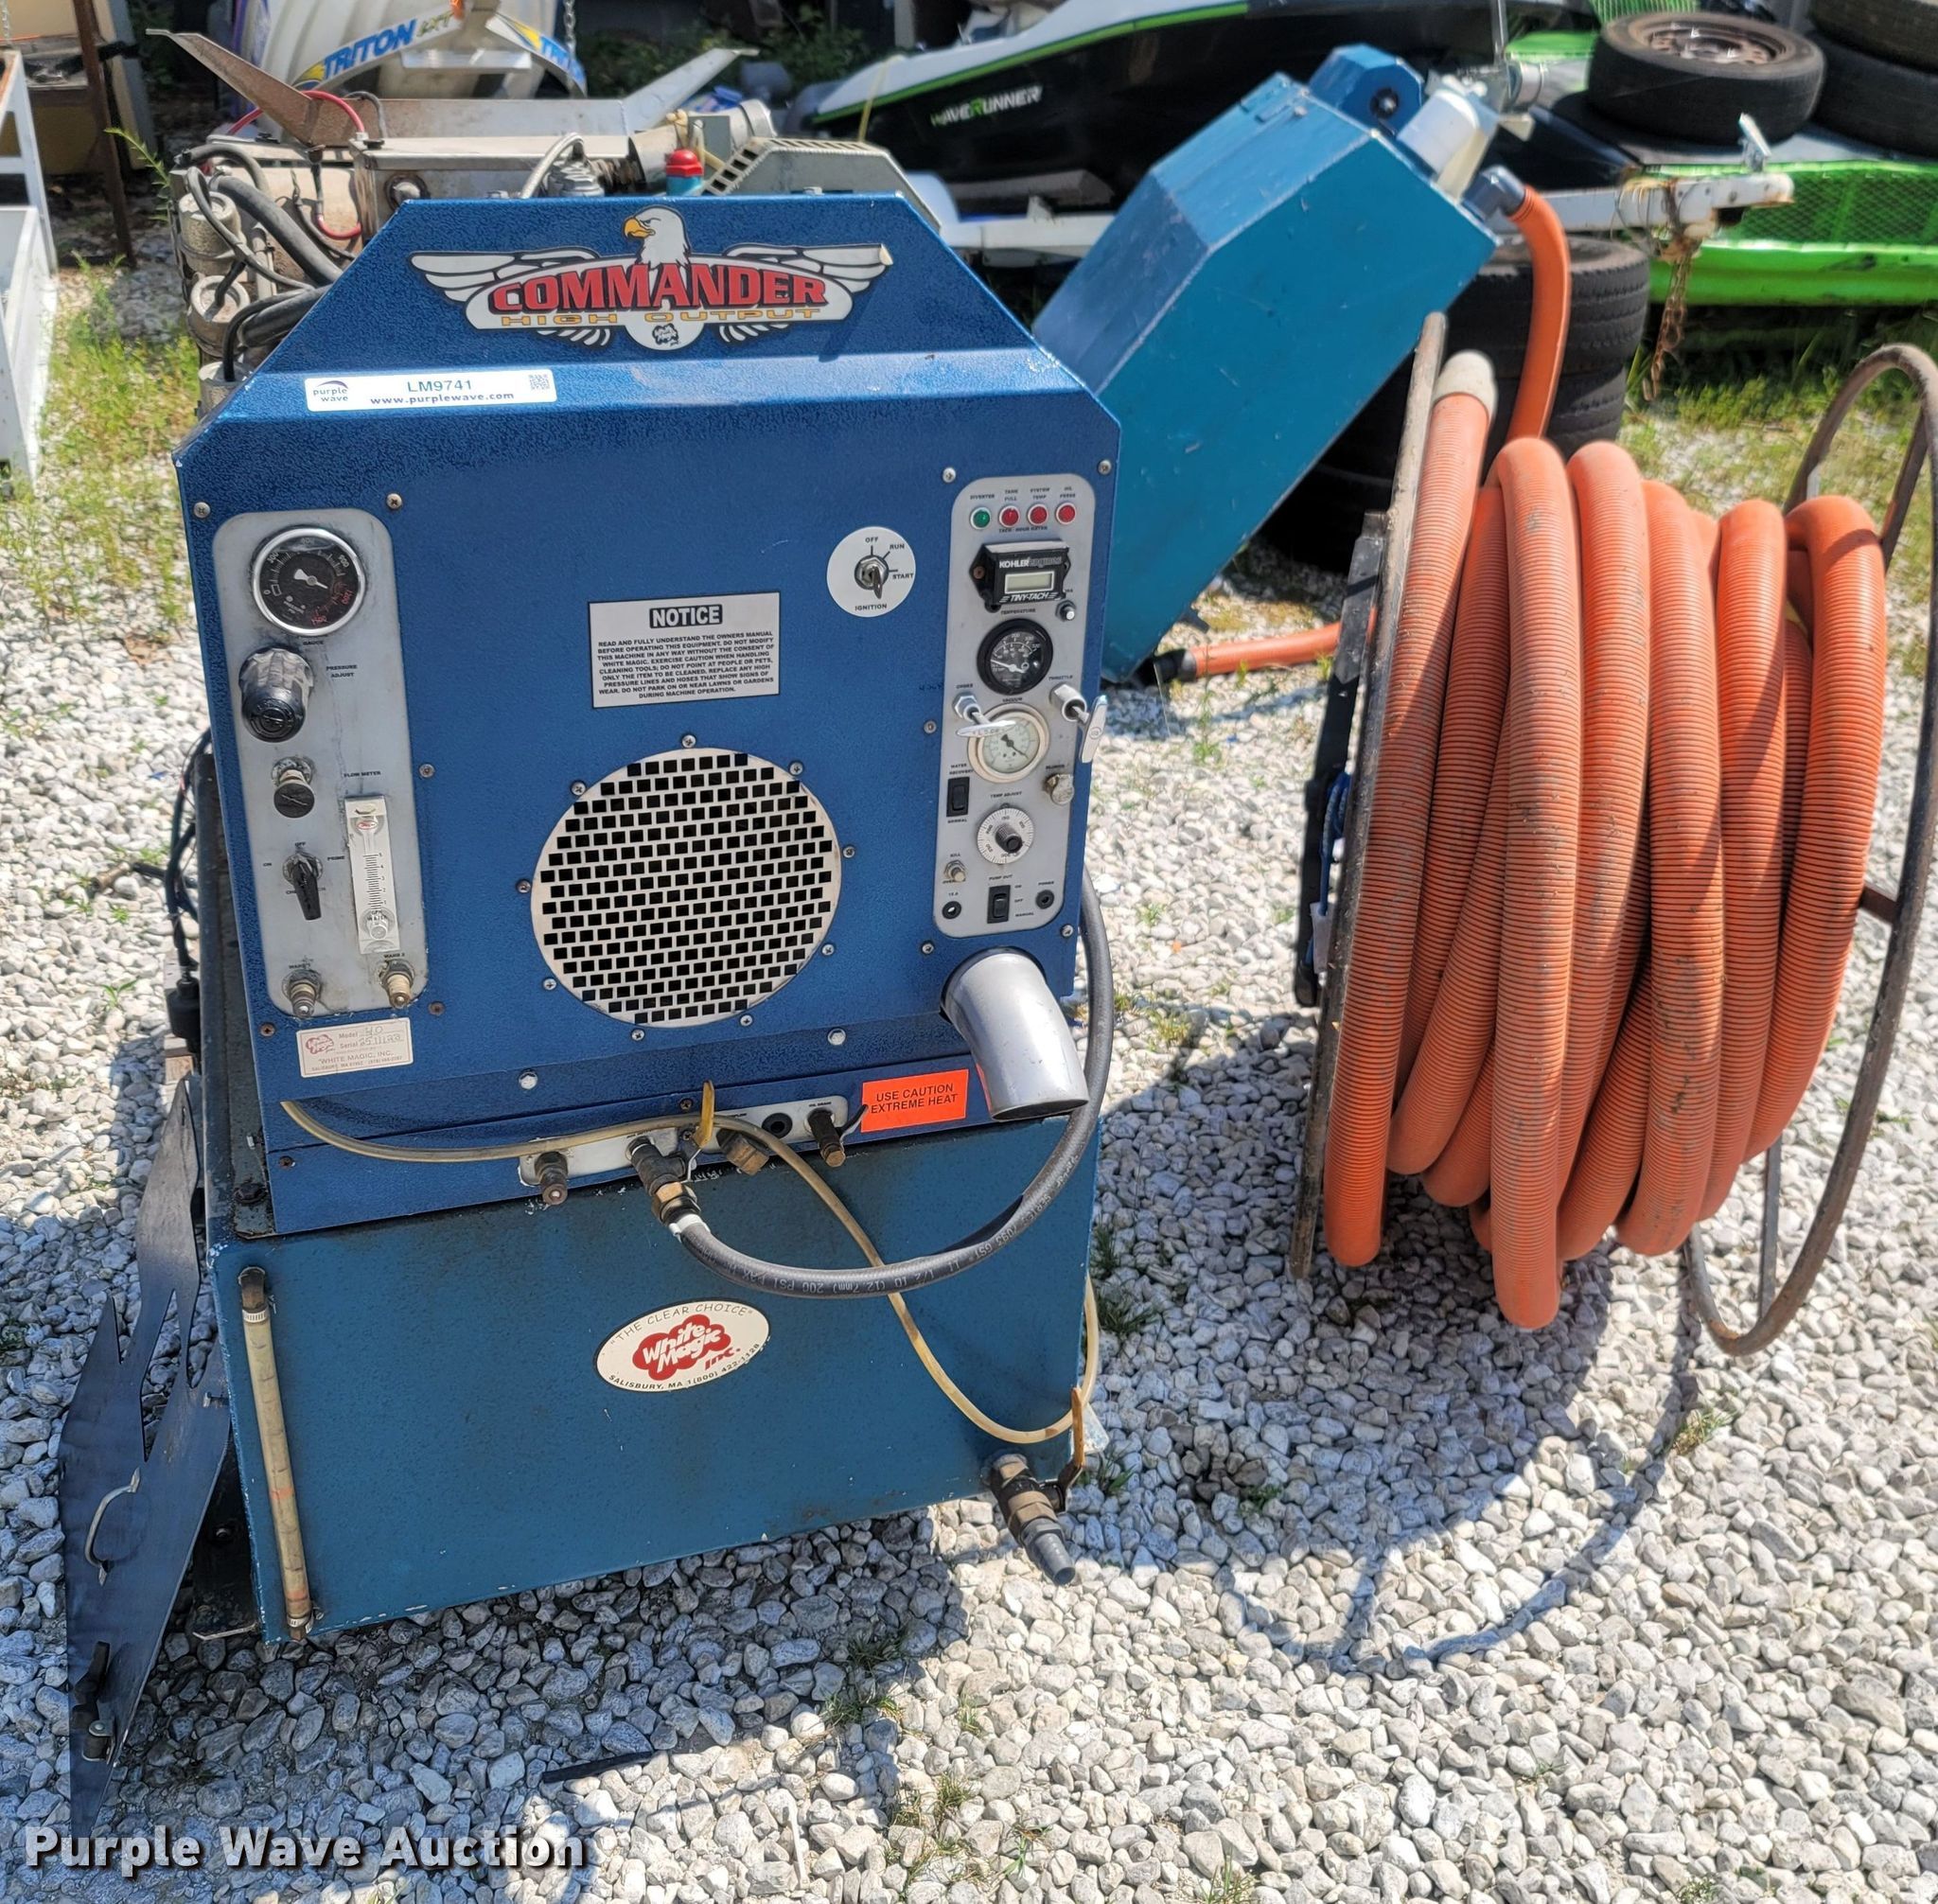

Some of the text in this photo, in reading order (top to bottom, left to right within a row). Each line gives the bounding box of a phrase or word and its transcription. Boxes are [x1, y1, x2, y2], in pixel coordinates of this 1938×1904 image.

[322, 19, 418, 79] TRITON
[930, 85, 1043, 126] WAVERUNNER
[488, 263, 828, 313] COMMANDER
[502, 309, 820, 326] HIGH OUTPUT
[313, 387, 347, 396] purple
[408, 380, 471, 393] LM9741
[371, 392, 514, 405] www.purplewave.com
[999, 558, 1030, 568] KOHLER
[1011, 592, 1048, 602] TINY-TACH
[652, 606, 720, 627] NOTICE
[876, 1084, 953, 1102] USE CAUTION
[871, 1094, 959, 1113] EXTREME HEAT
[773, 1281, 795, 1291] PSI
[802, 1281, 824, 1294] 200
[647, 1308, 689, 1325] CLEAR
[643, 1322, 706, 1365] White
[657, 1327, 722, 1372] Magic
[608, 1374, 664, 1389] SALISBURY,
